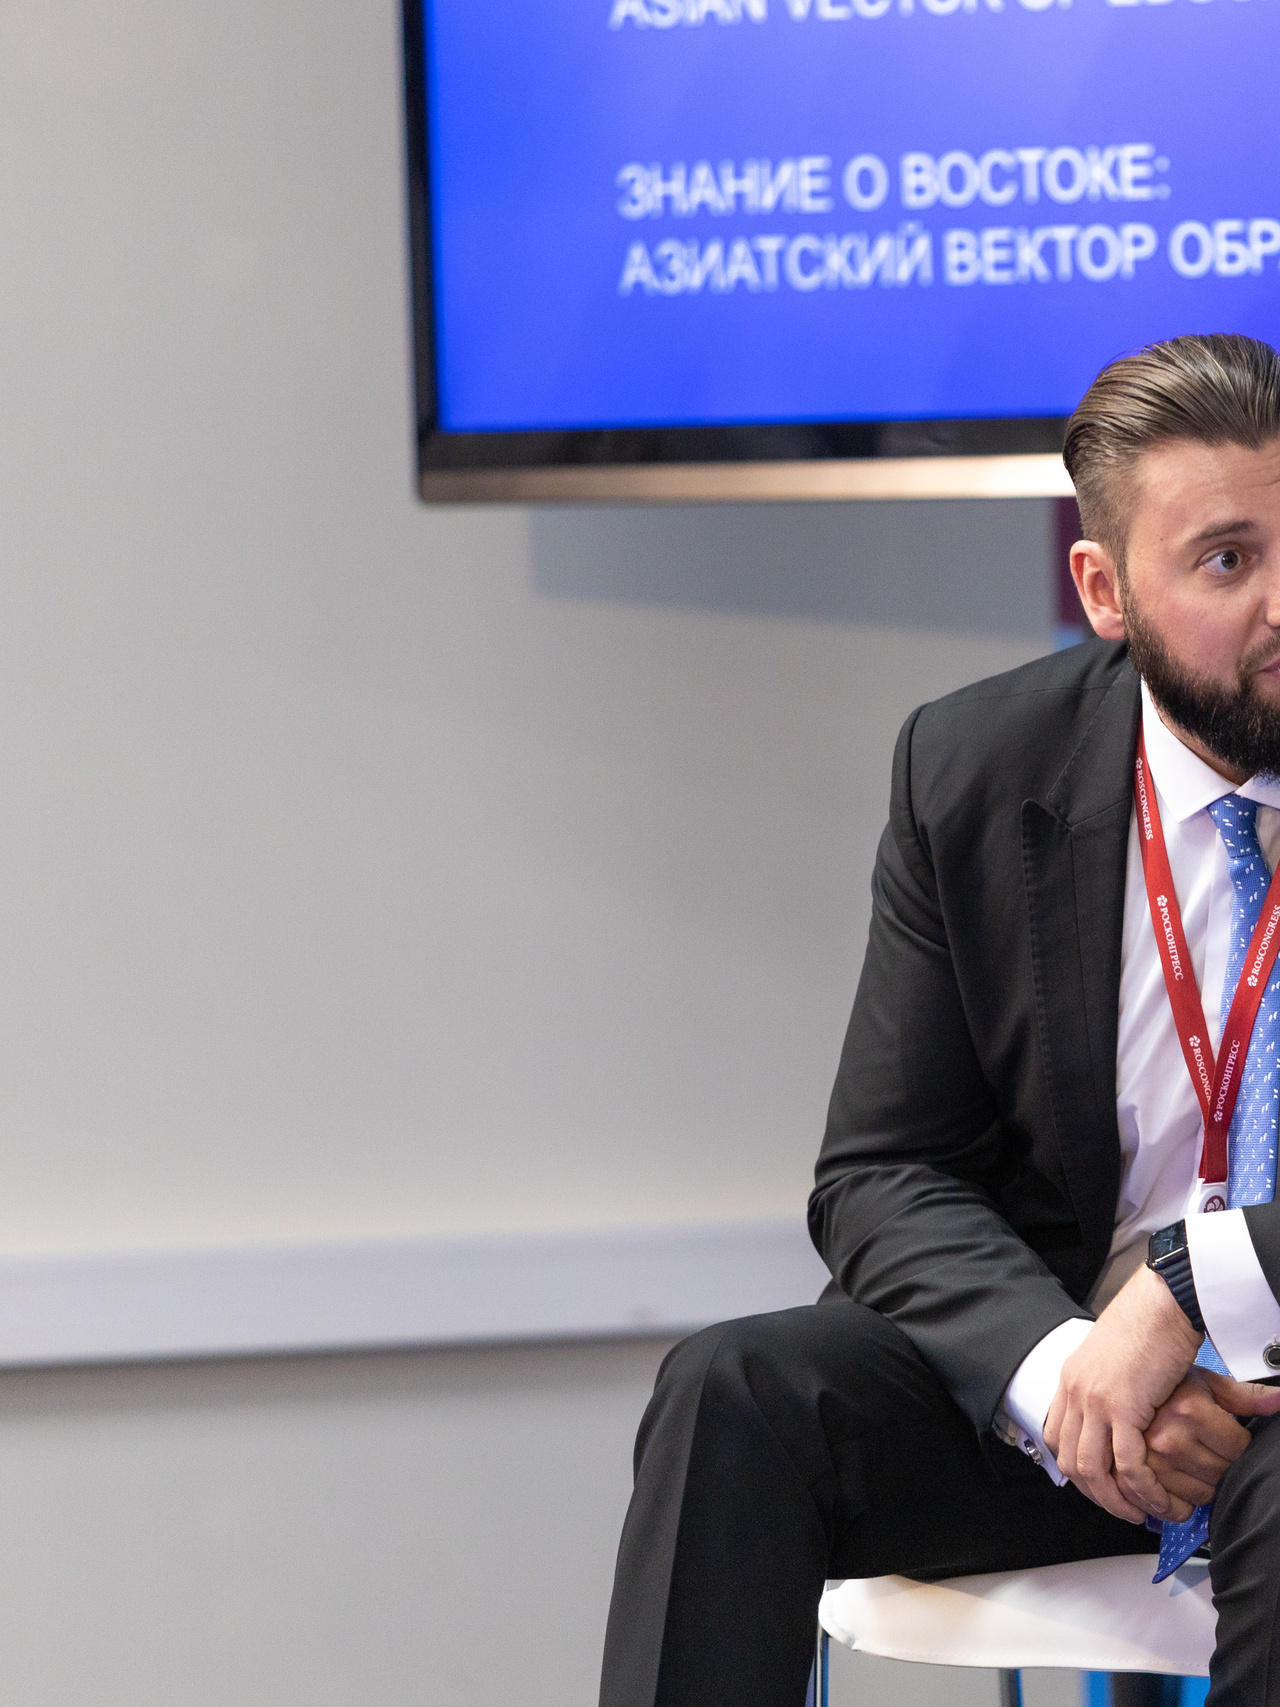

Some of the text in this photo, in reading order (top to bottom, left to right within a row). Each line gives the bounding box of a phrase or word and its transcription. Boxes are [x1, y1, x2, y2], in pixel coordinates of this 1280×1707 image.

[617, 143, 1171, 220] ЗНАНИЕ О ВОСТОКЕ:
[617, 219, 933, 297] АЗИАТСКИЙ
[943, 223, 1157, 287] ВЕКТОР
[1137, 769, 1154, 840] ROSCONGRESS
[1160, 906, 1184, 980] РОСКОНГРЕСС
[1216, 1040, 1241, 1110] РОСКОНГРЕСС
